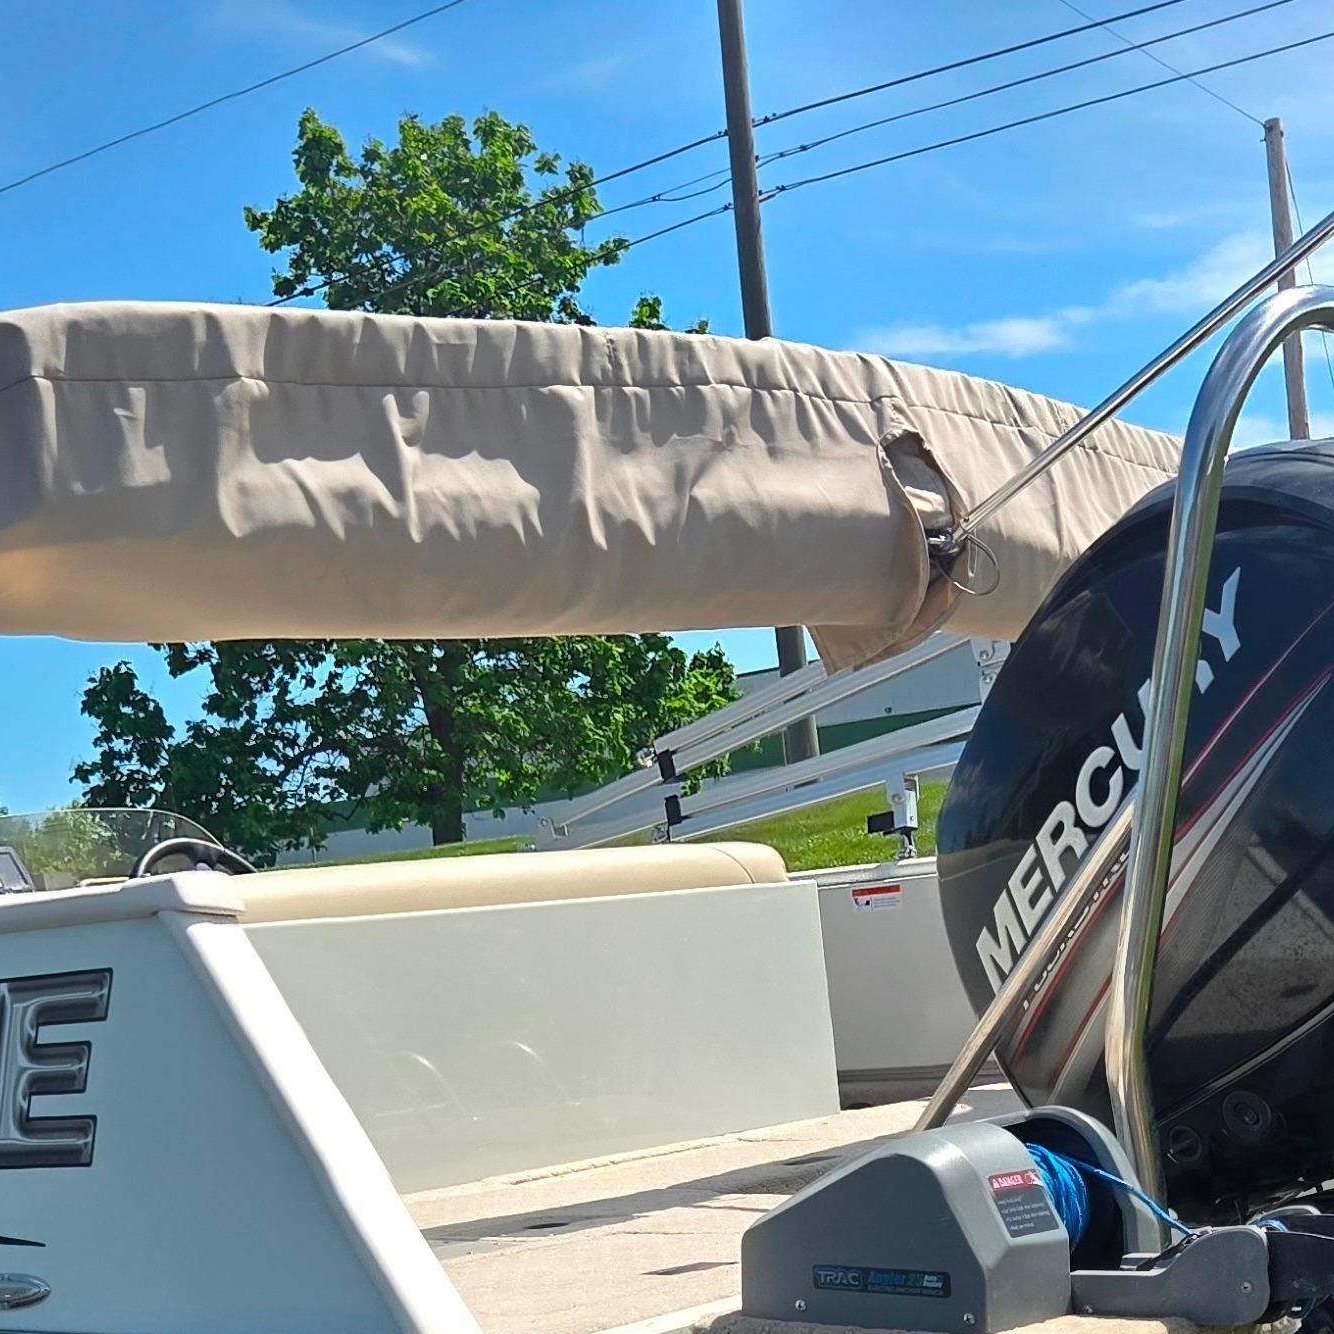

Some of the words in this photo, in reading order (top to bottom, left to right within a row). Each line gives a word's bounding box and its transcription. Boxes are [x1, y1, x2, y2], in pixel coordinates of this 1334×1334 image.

[975, 565, 1241, 995] MERCUY
[816, 1270, 859, 1285] TRAC
[868, 1270, 907, 1286] Angler
